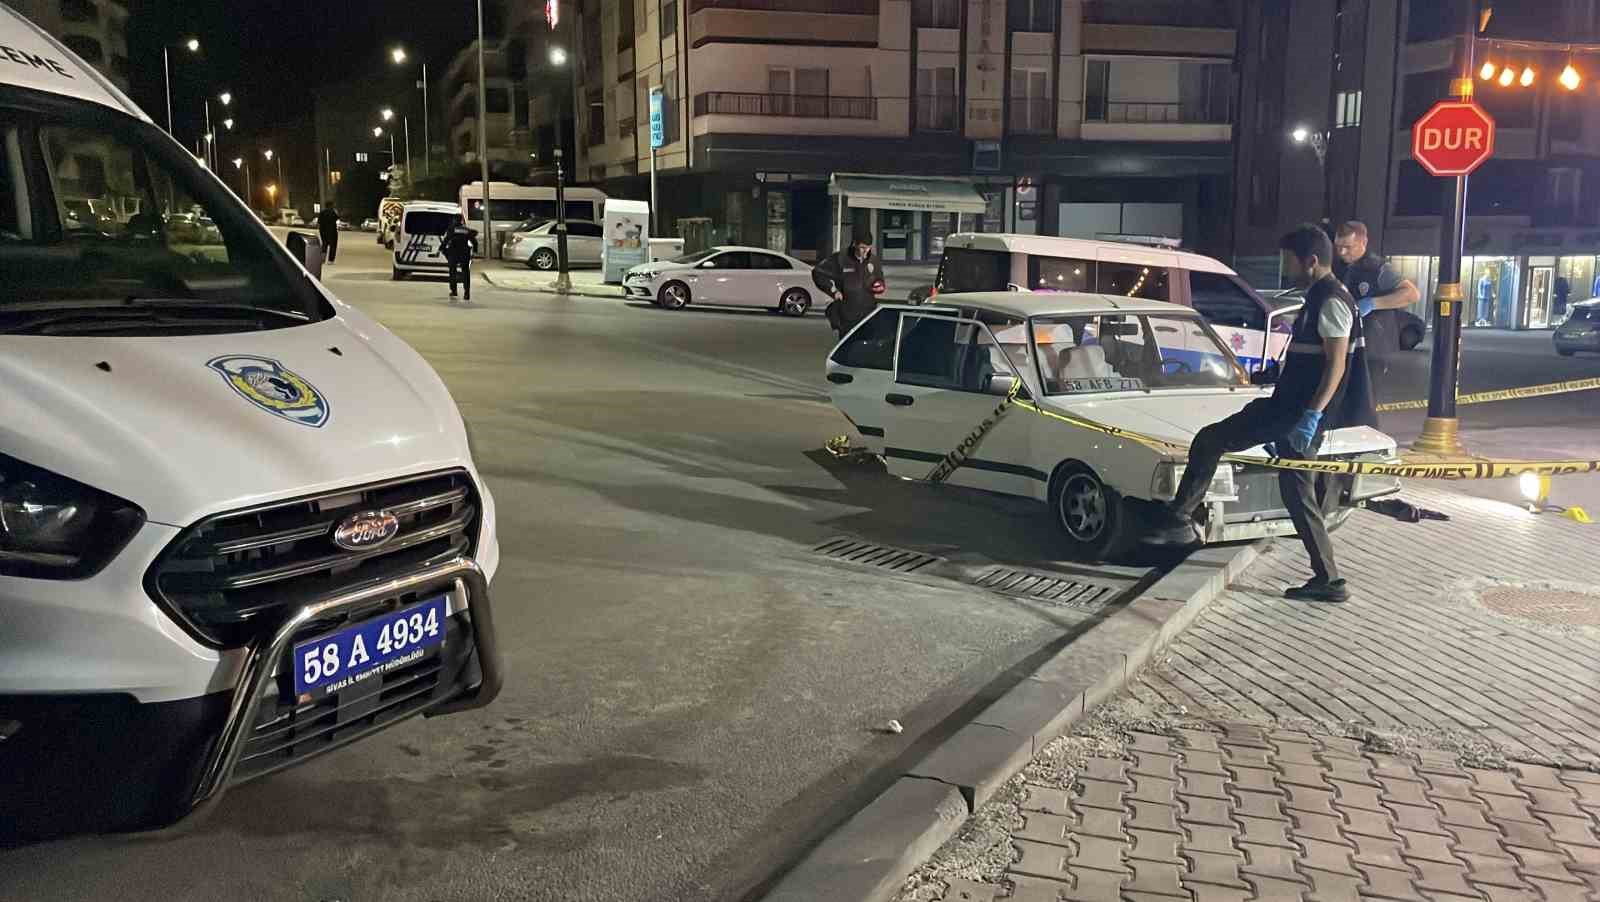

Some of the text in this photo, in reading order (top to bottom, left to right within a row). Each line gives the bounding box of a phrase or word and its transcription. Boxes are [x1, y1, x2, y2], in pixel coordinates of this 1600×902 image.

[1423, 127, 1482, 150] DUR
[304, 607, 439, 684] 58 A 4934
